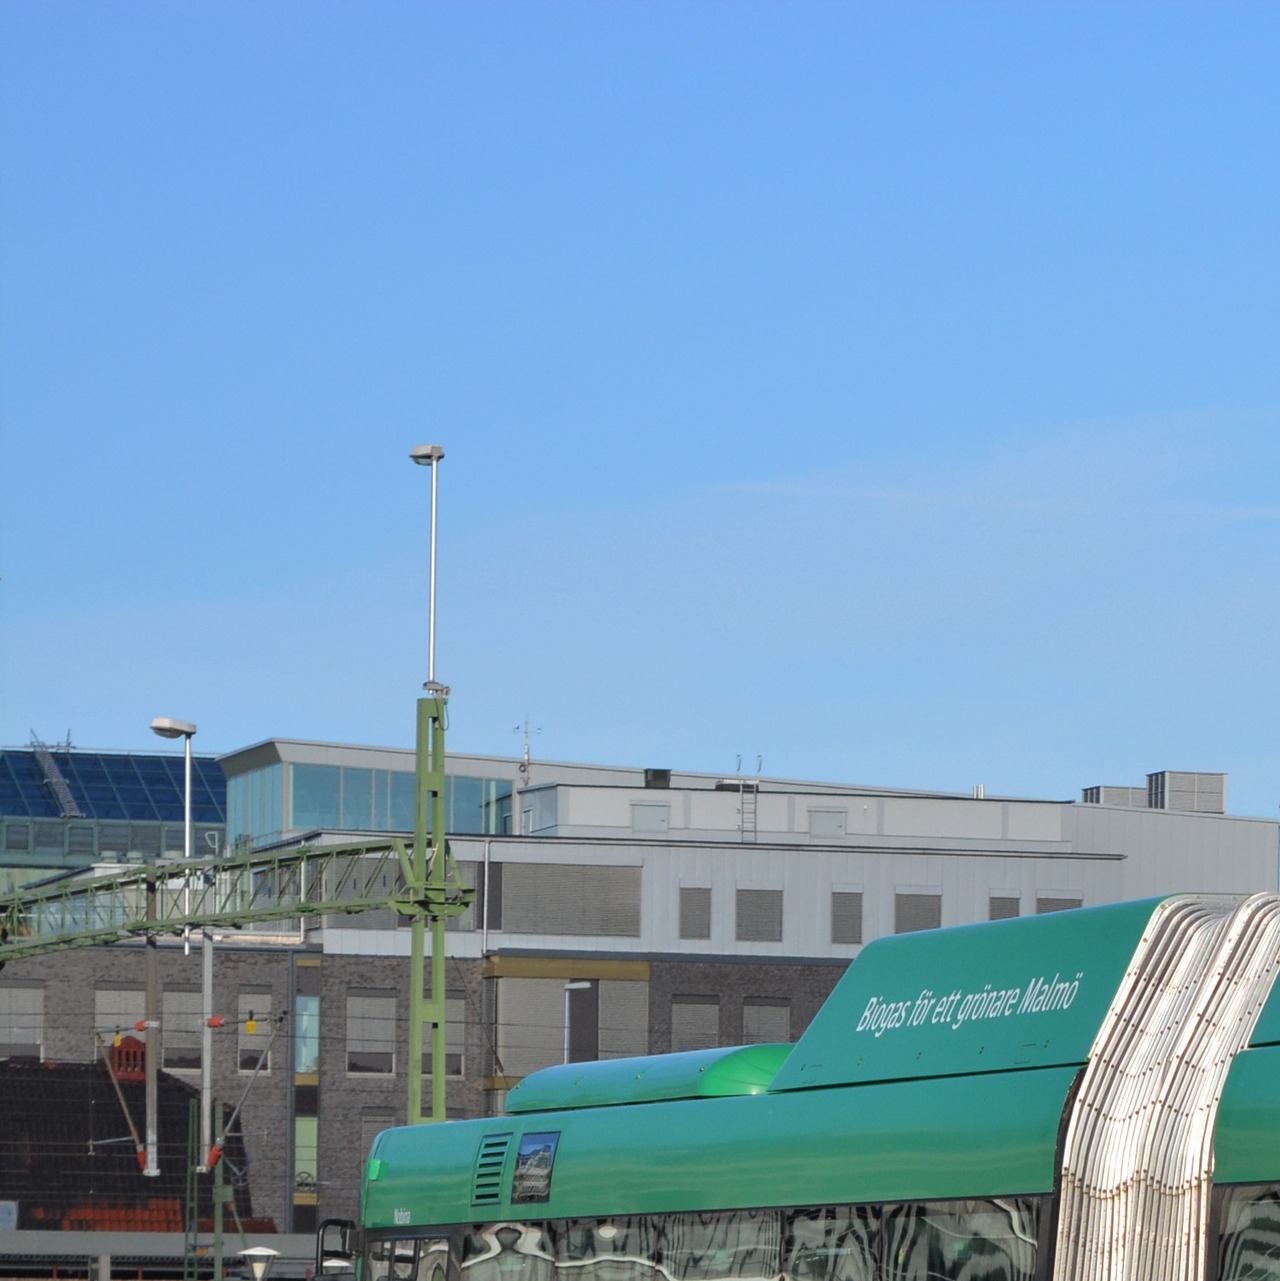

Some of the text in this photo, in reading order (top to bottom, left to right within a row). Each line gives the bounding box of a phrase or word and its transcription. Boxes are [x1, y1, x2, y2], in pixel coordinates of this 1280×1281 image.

[856, 972, 1083, 1038] Biogas för ett grönare Malmö
